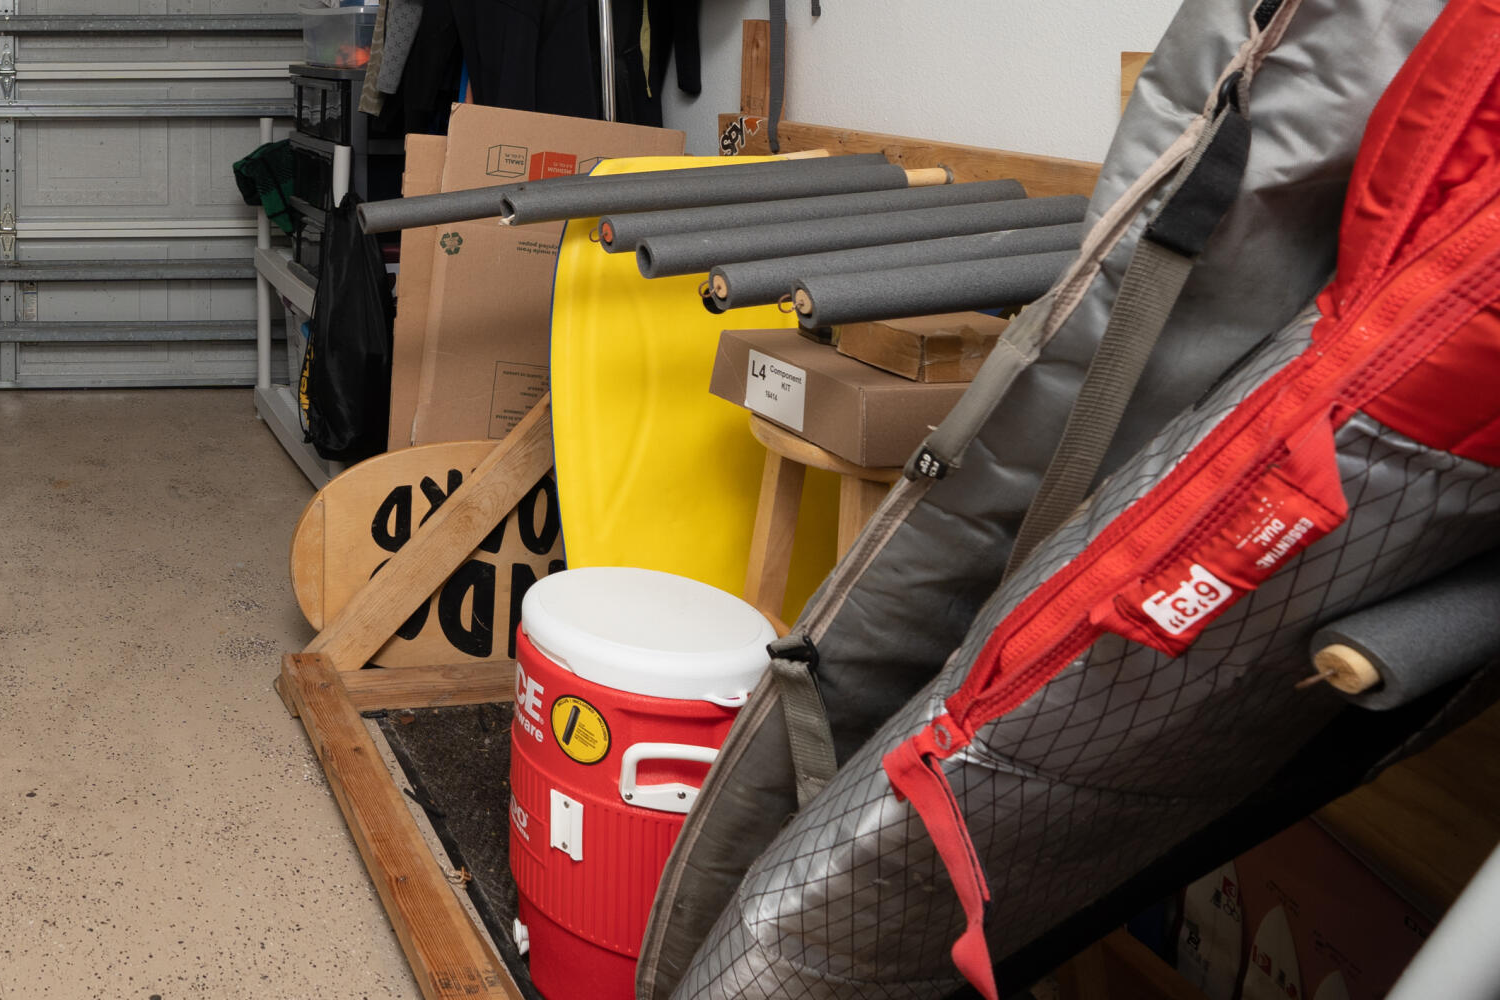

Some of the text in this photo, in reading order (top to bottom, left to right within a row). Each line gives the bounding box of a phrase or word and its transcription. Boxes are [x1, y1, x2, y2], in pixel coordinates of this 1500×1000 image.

[751, 360, 803, 385] L4 Component
[781, 382, 791, 392] KIT
[1255, 516, 1315, 568] ESSENTIAL
